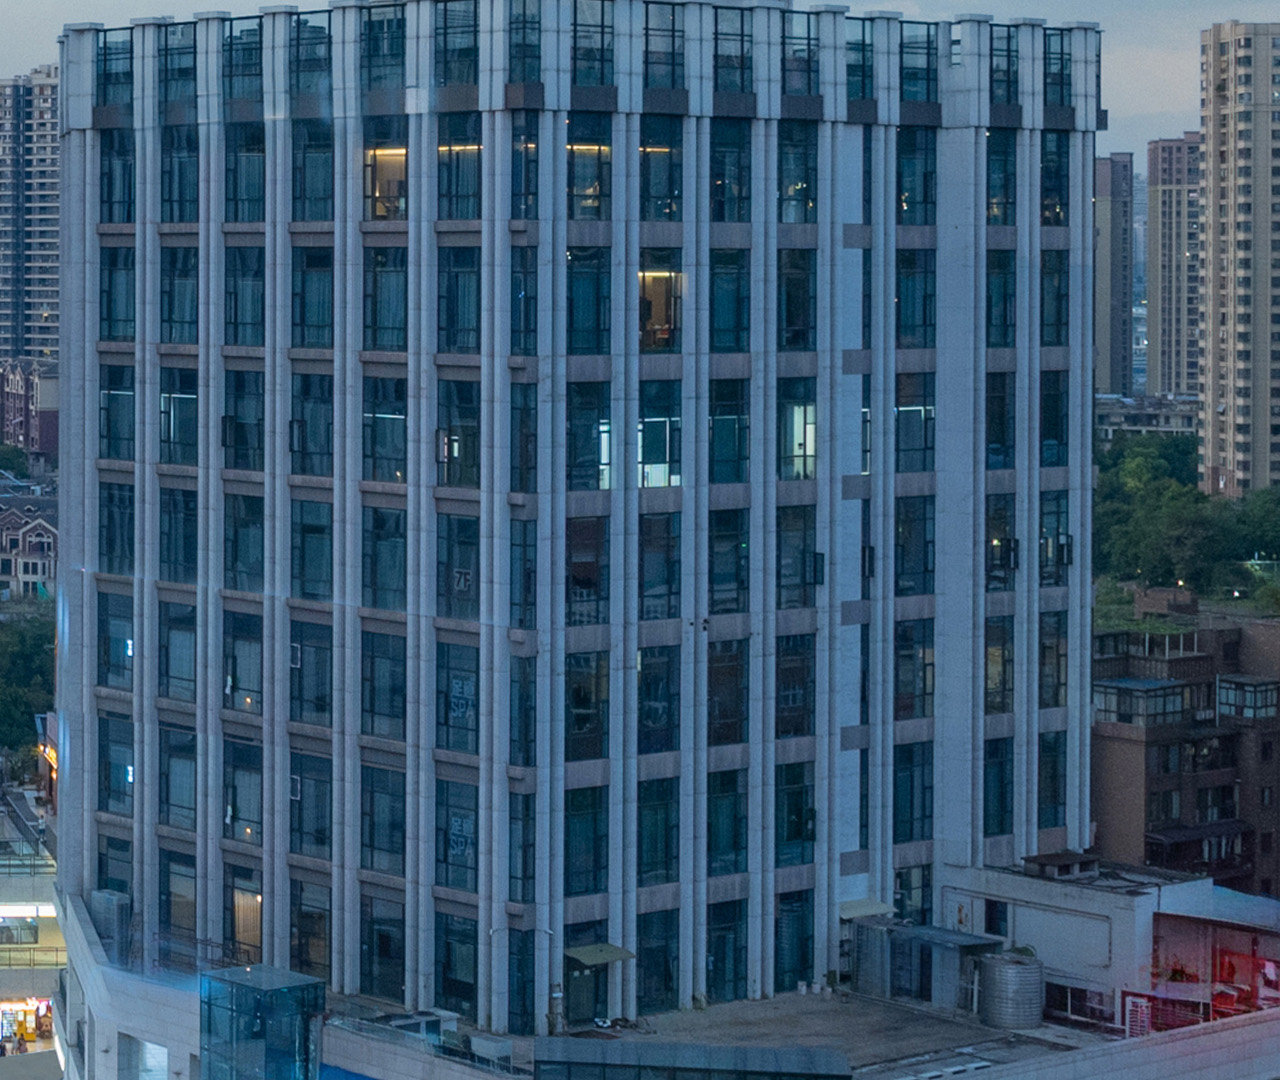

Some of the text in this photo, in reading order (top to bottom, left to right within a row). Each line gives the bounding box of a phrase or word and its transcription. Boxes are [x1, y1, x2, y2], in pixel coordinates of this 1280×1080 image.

[454, 569, 471, 590] 7F
[451, 698, 474, 717] SPA
[450, 835, 474, 857] SPA
